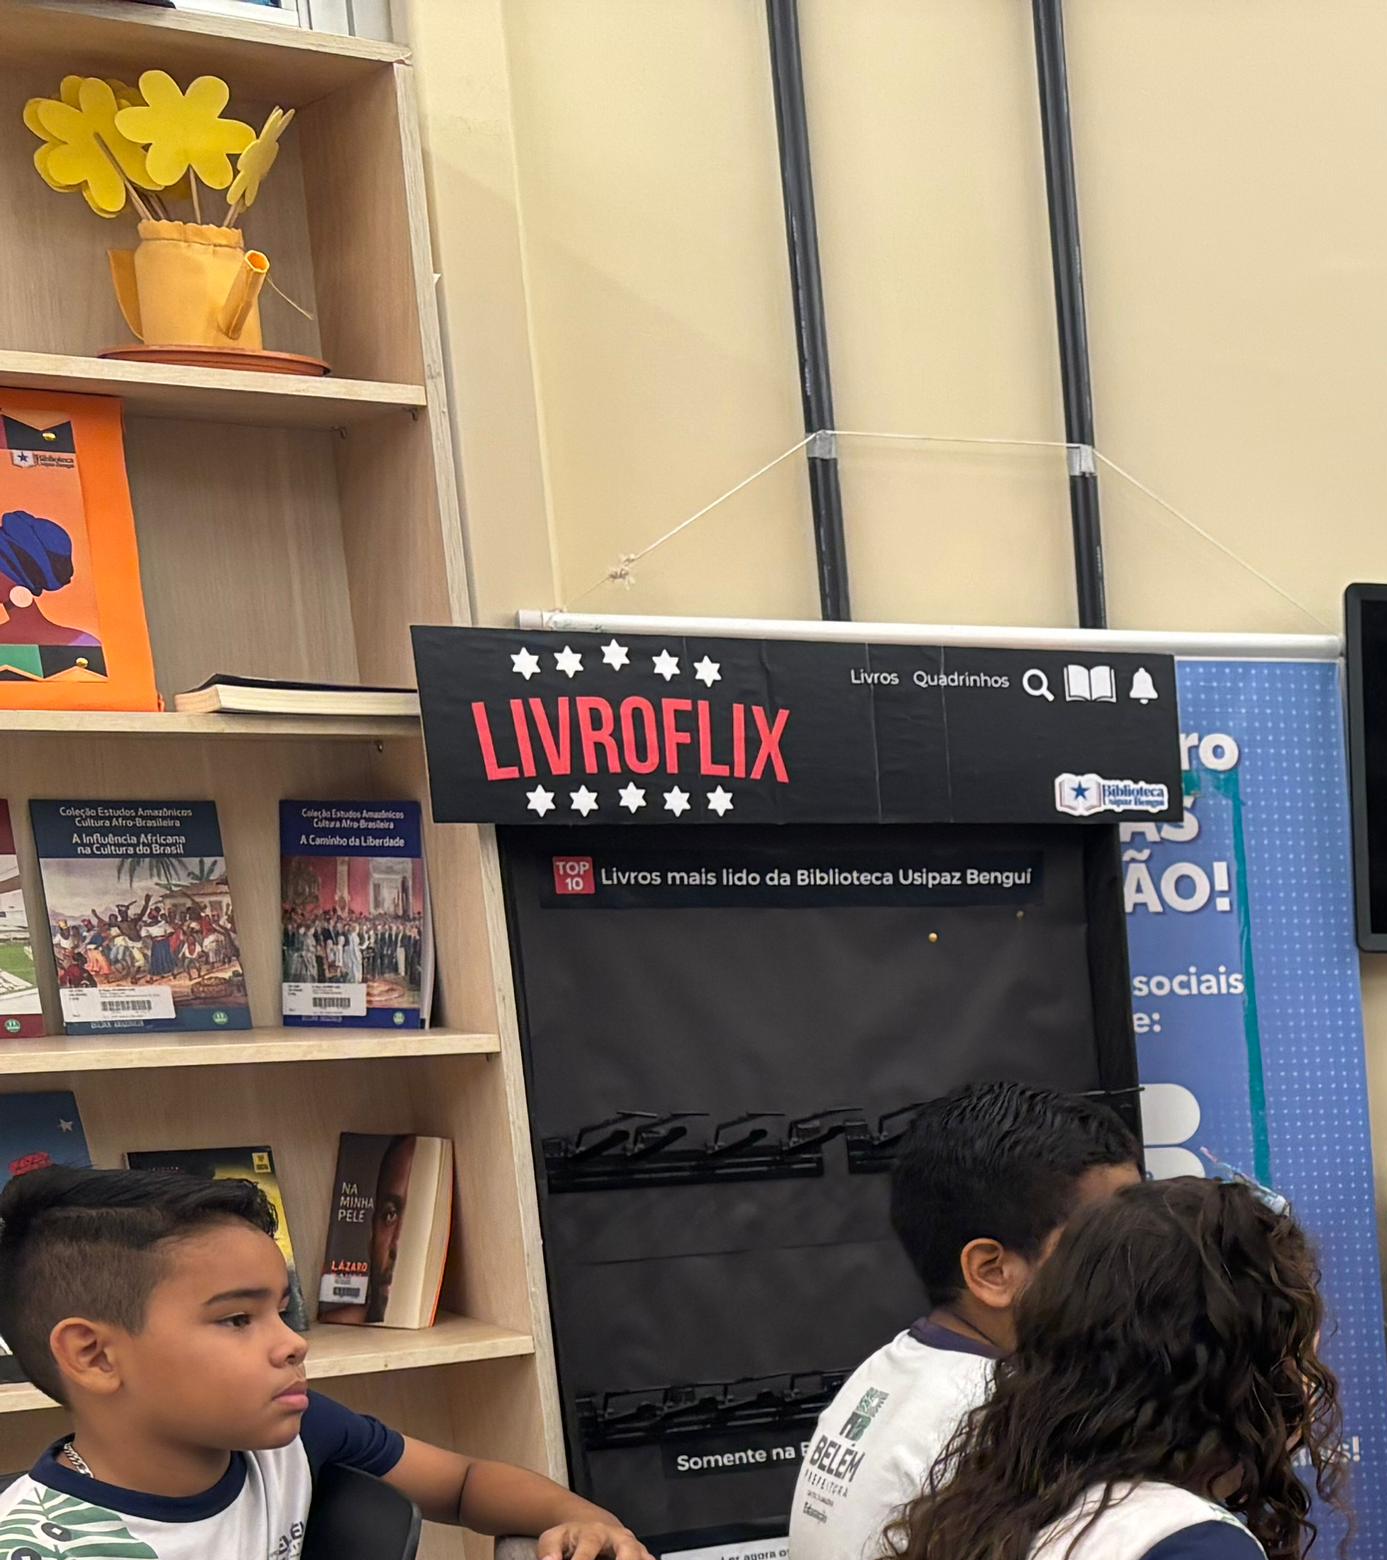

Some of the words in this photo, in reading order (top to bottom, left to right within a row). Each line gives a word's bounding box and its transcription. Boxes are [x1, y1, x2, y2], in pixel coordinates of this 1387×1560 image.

[850, 669, 900, 685] Livros
[913, 671, 1010, 688] Quadrinhos
[471, 696, 790, 783] LIVROFLIX
[1102, 784, 1165, 797] Biblioteca
[60, 807, 96, 818] Coleção
[98, 807, 136, 817] Estudos
[138, 807, 193, 817] Amazônicos
[301, 808, 330, 819] Coleção
[332, 809, 360, 818] Estudos
[75, 817, 110, 827] Cultura
[112, 817, 181, 828] Afro-Brasileira
[313, 818, 340, 828] Cultura
[341, 819, 394, 829] Afro-Brasileira
[72, 833, 81, 844] A
[83, 833, 137, 844] Influência
[140, 833, 186, 844] Africana
[300, 835, 308, 845] A
[309, 835, 347, 846] Caminho
[349, 836, 360, 846] da
[361, 836, 405, 847] Liberdade
[77, 846, 91, 855] na
[93, 844, 133, 854] Cultura
[136, 844, 150, 854] do
[152, 844, 184, 855] Brasil
[555, 861, 590, 875] TOP
[565, 878, 584, 891] 10
[601, 868, 661, 885] Livros
[667, 868, 717, 885] mais
[723, 868, 760, 886] lido
[766, 869, 791, 886] da
[797, 868, 893, 886] Biblioteca
[899, 868, 962, 888] Usipaz
[1132, 966, 1245, 996] sociais
[341, 1182, 358, 1196] NA
[340, 1196, 374, 1209] MINHA
[338, 1209, 366, 1222] PELE
[677, 1449, 767, 1471] Somente
[772, 1446, 796, 1461] na
[810, 1434, 866, 1483] BELÉM
